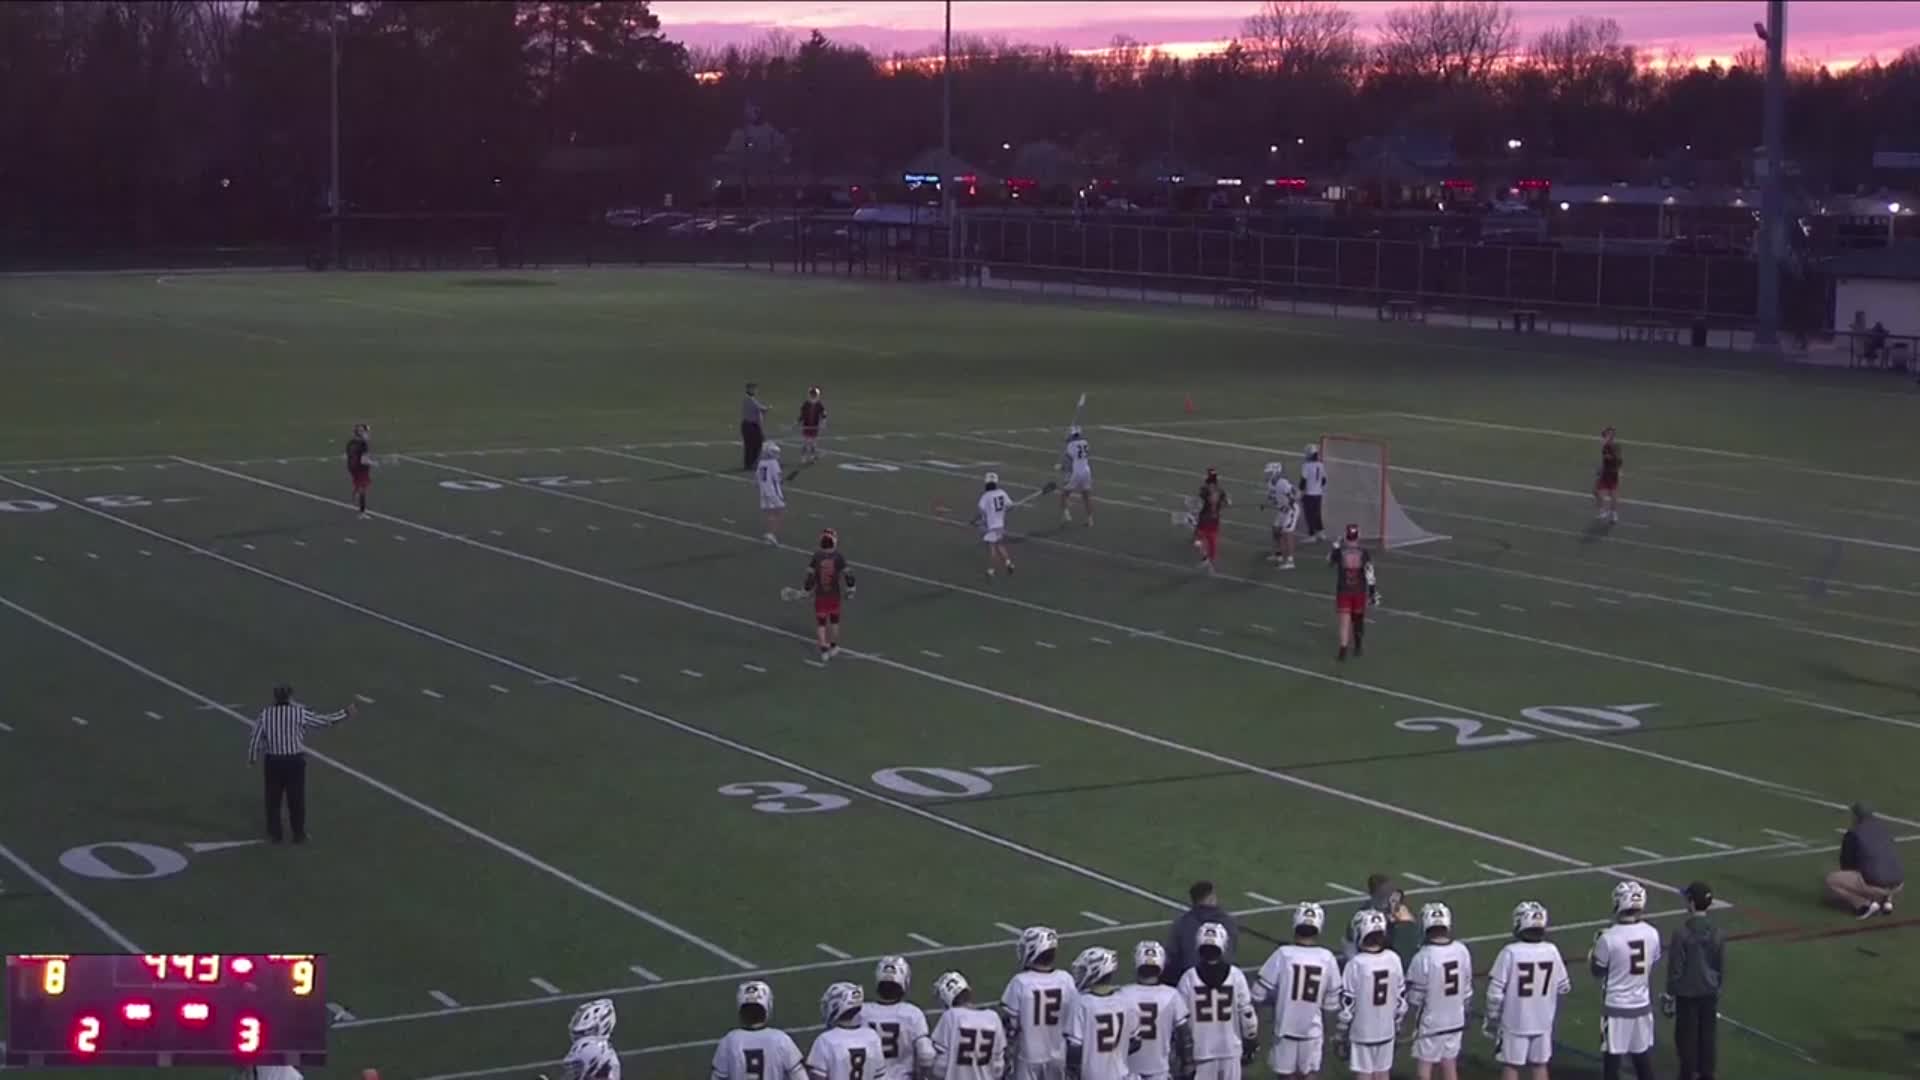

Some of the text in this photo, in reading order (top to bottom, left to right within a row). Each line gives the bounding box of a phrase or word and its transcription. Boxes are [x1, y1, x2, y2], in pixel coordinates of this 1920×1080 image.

[1628, 939, 1646, 976] 2
[1292, 963, 1323, 1003] 16
[1372, 969, 1390, 1007] 6
[1443, 960, 1459, 997] 5
[1517, 961, 1553, 998] 27
[1032, 988, 1063, 1026] 12
[1195, 984, 1234, 1023] 22
[868, 1021, 901, 1059] 3
[958, 1027, 996, 1067] 23
[1095, 1012, 1124, 1053] 21
